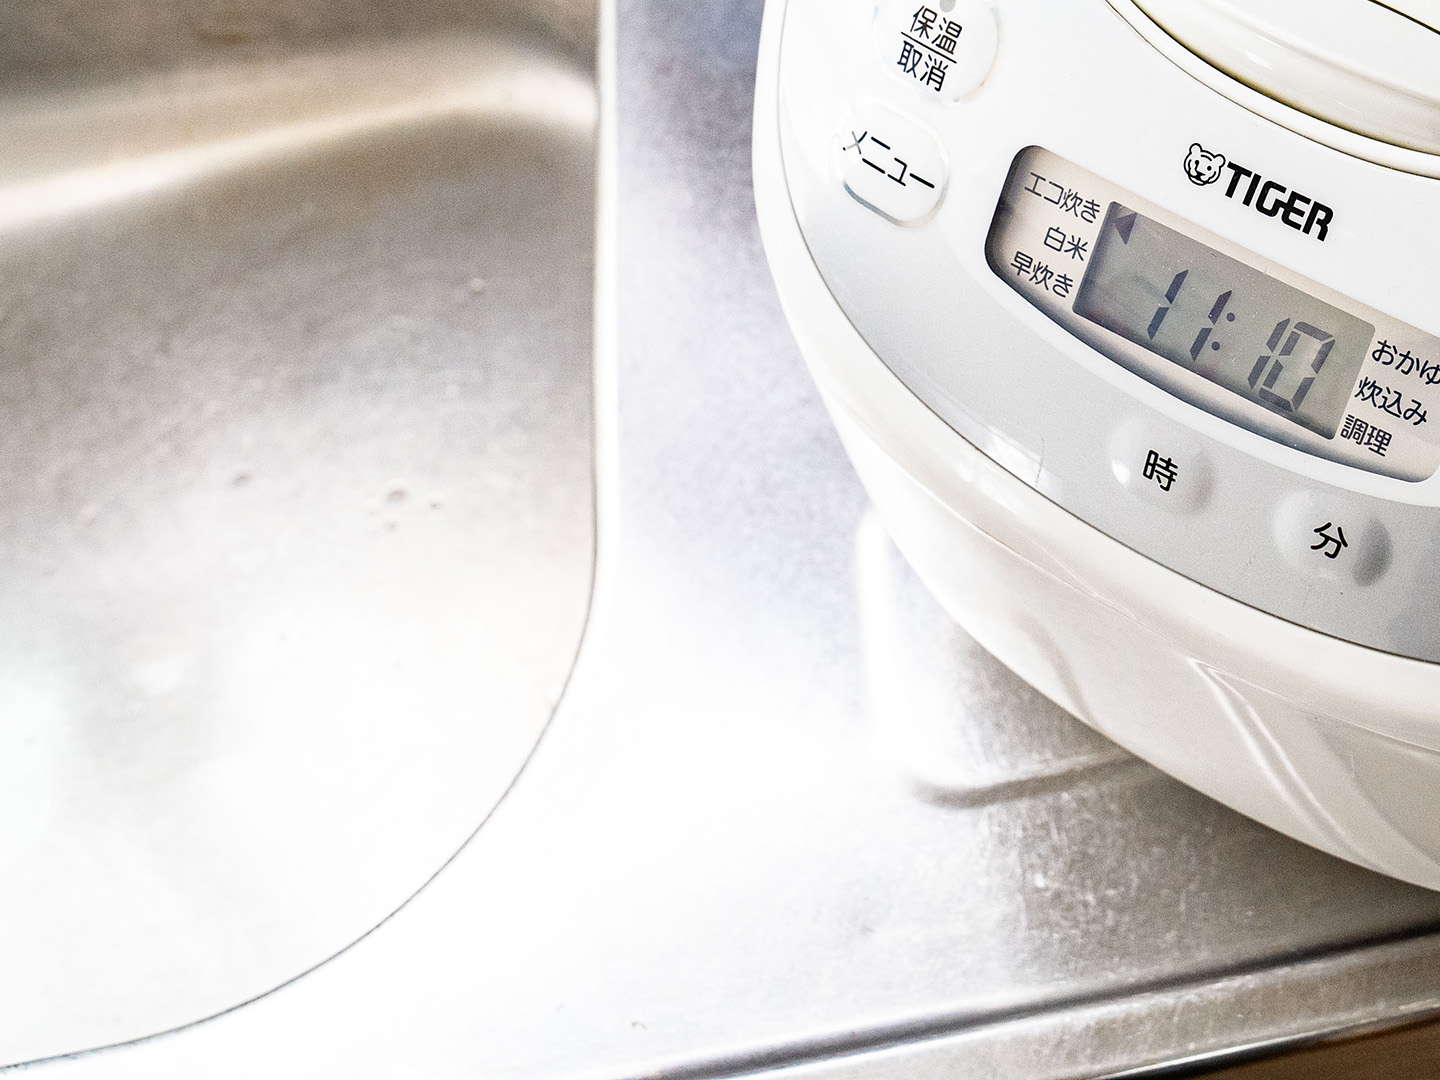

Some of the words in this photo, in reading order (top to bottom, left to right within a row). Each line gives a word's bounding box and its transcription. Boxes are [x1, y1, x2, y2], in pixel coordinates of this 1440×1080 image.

[909, 5, 963, 56] 保温
[896, 40, 949, 92] 取消
[842, 131, 935, 189] メニュー
[1024, 172, 1101, 223] エコ炊き
[1225, 162, 1334, 242] TIGER
[1043, 226, 1088, 261] 白米
[1010, 251, 1074, 298] 早炊き
[1146, 269, 1337, 414] 11:10
[1355, 377, 1428, 427] 炊込み
[1340, 414, 1393, 457] 調理
[1142, 449, 1179, 492] 時
[1311, 522, 1349, 559] 分
